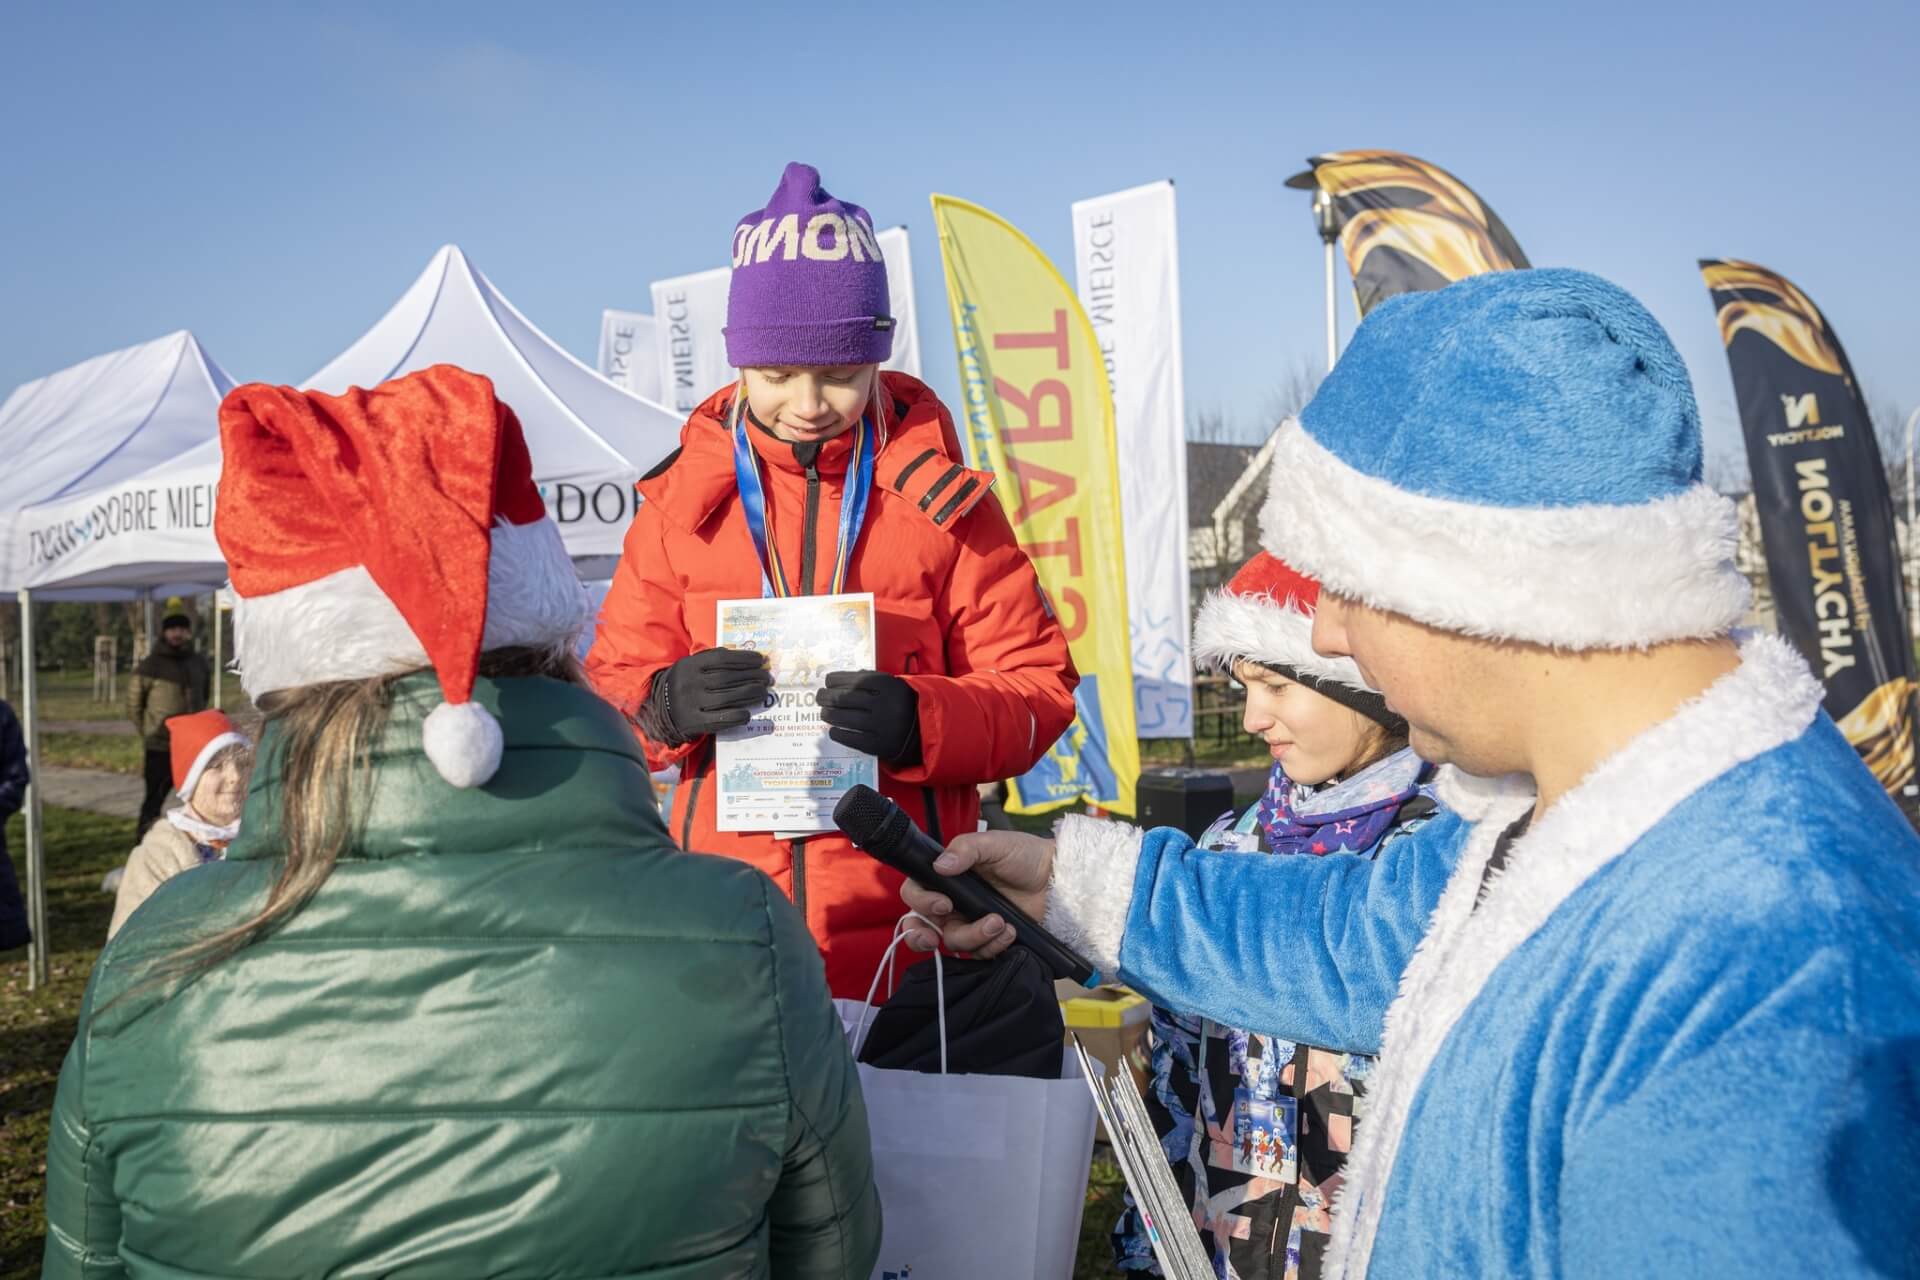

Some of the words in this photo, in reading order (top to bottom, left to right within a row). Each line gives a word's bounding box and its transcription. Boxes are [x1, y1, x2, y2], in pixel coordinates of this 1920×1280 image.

[92, 490, 157, 541] DOBRE
[166, 485, 213, 528] MIEJ
[764, 692, 817, 708] DYPLO
